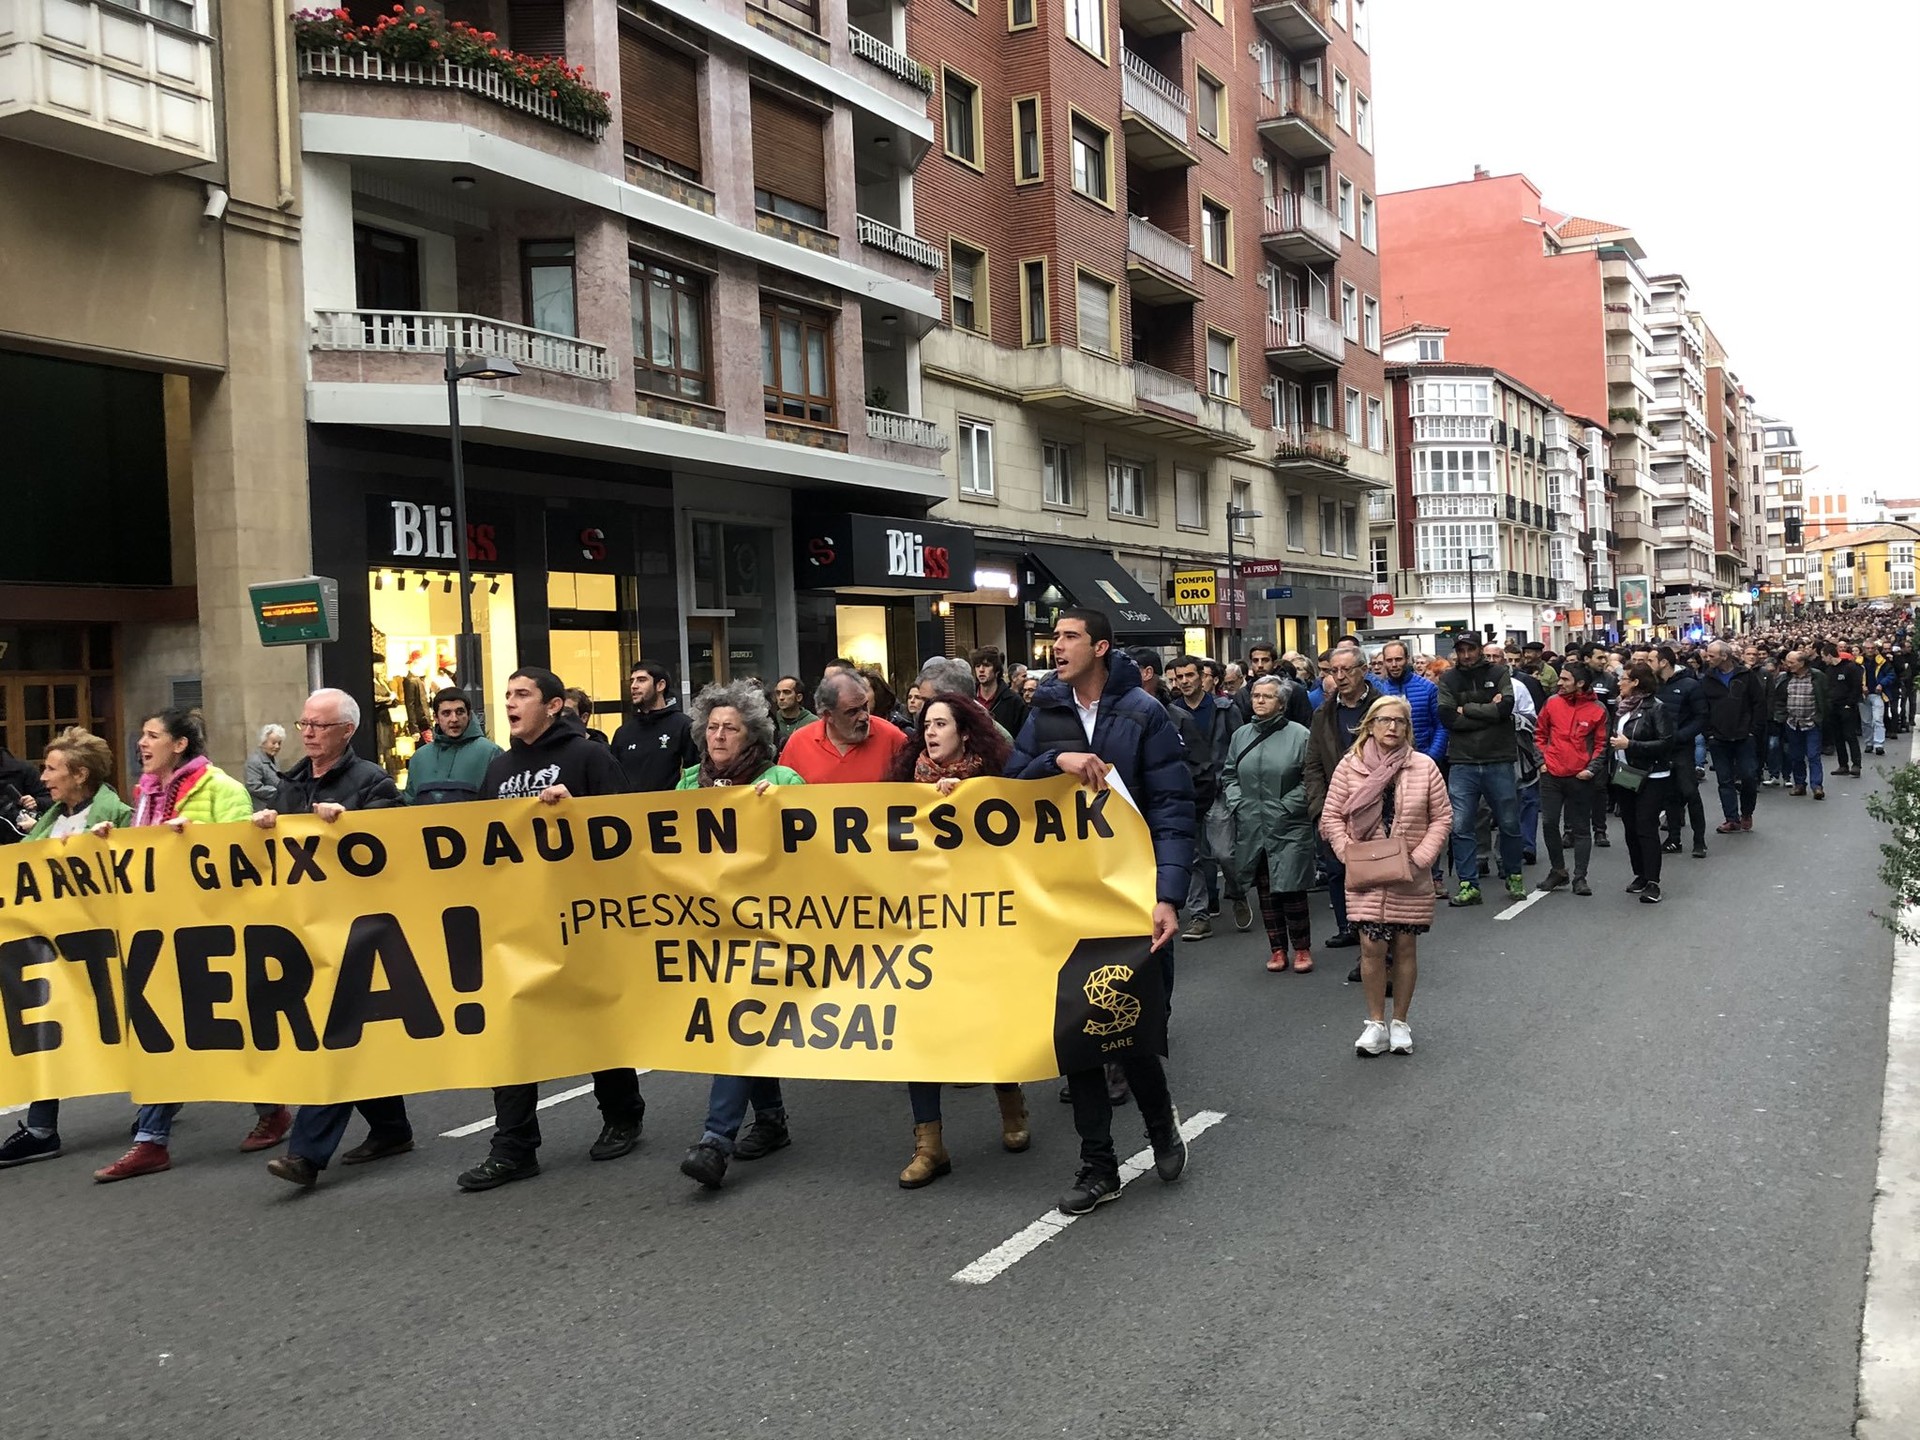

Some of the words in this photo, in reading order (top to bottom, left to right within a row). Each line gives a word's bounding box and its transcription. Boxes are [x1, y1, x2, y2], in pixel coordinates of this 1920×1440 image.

[886, 529, 949, 579] Bliss
[1253, 563, 1278, 573] PRENSA
[1176, 576, 1214, 584] COMPRO
[1180, 588, 1210, 599] ORO
[0, 847, 155, 908] ARRIKI
[190, 832, 387, 890] GAIXO
[422, 807, 738, 870] DAUDEN
[781, 788, 1115, 854] PRESOAK
[559, 894, 720, 946] ¡PRESXS
[732, 890, 1018, 931] GRAVEMENTE
[655, 939, 934, 991] ENFERMXS
[685, 998, 714, 1044] A
[728, 998, 897, 1052] CASA!
[1101, 1037, 1134, 1053] SARE
